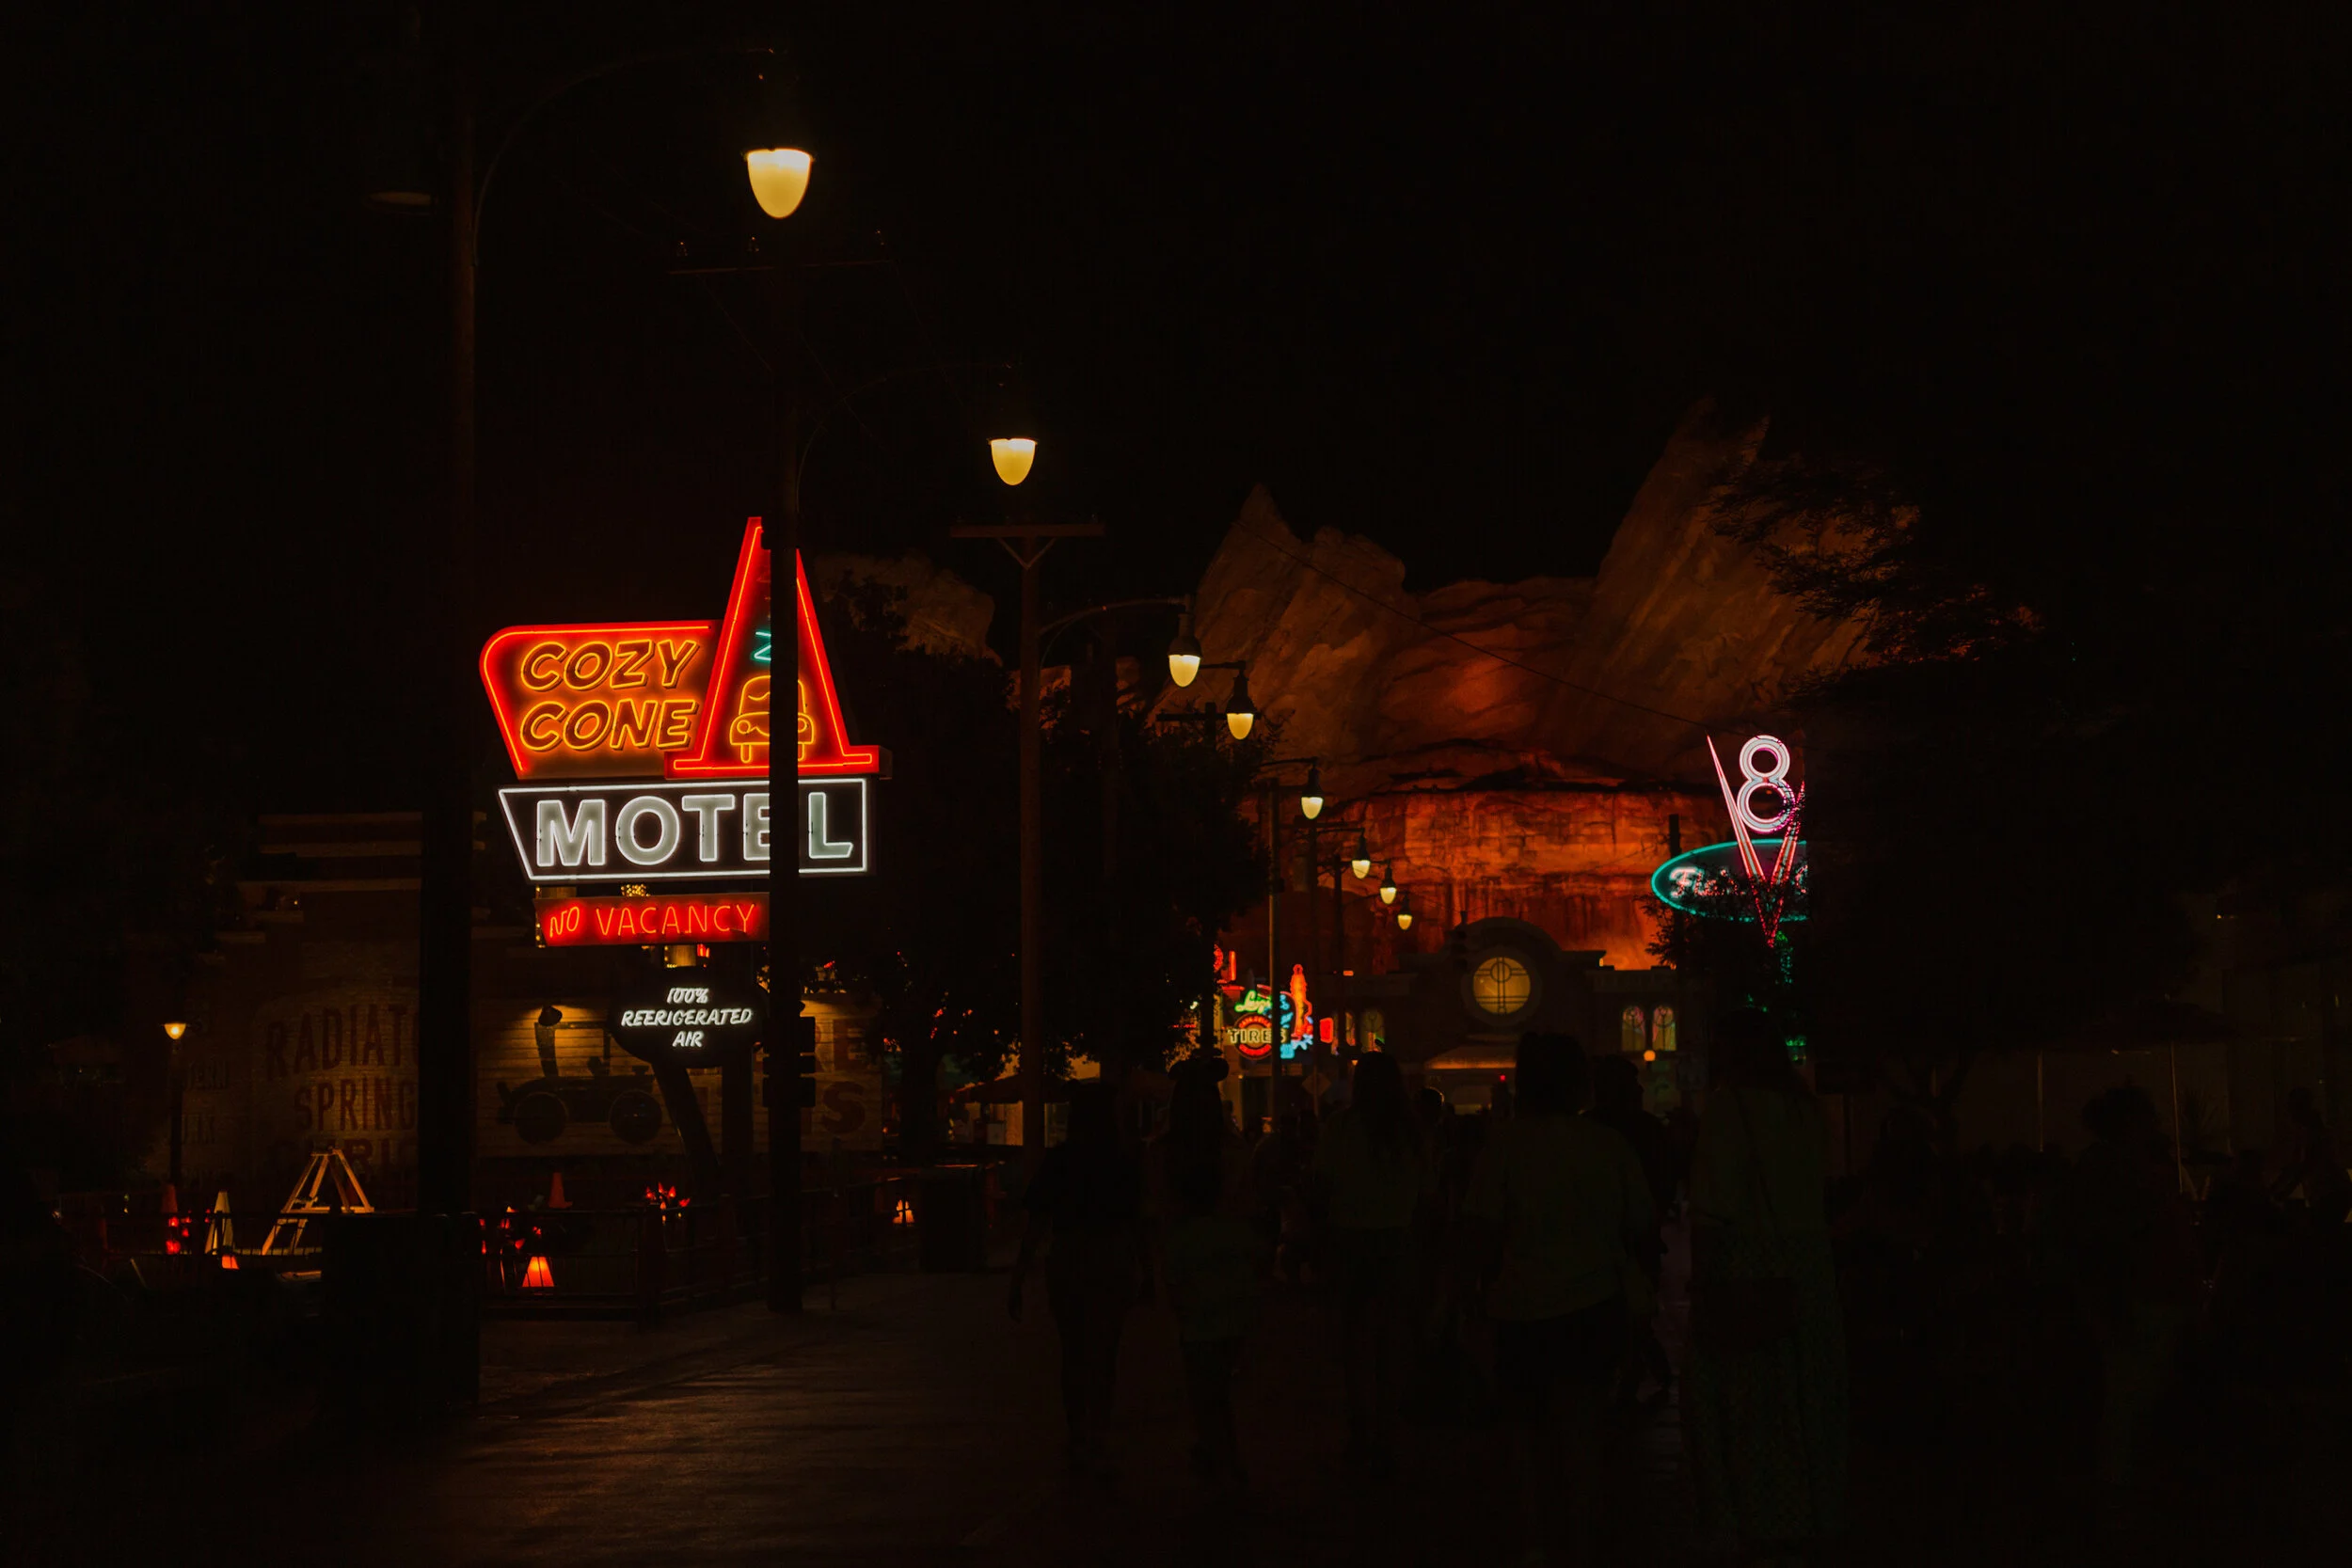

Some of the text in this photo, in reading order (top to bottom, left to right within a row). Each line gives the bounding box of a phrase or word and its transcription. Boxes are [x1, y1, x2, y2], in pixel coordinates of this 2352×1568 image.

[521, 639, 698, 691] COZY
[520, 698, 698, 750] CONE
[536, 791, 854, 866] MOTEL
[549, 903, 755, 938] NO VACANCY
[666, 987, 709, 1004] 100%
[266, 1004, 419, 1081] RADIAT
[672, 1030, 705, 1048] AIR
[294, 1078, 417, 1131] SPRING
